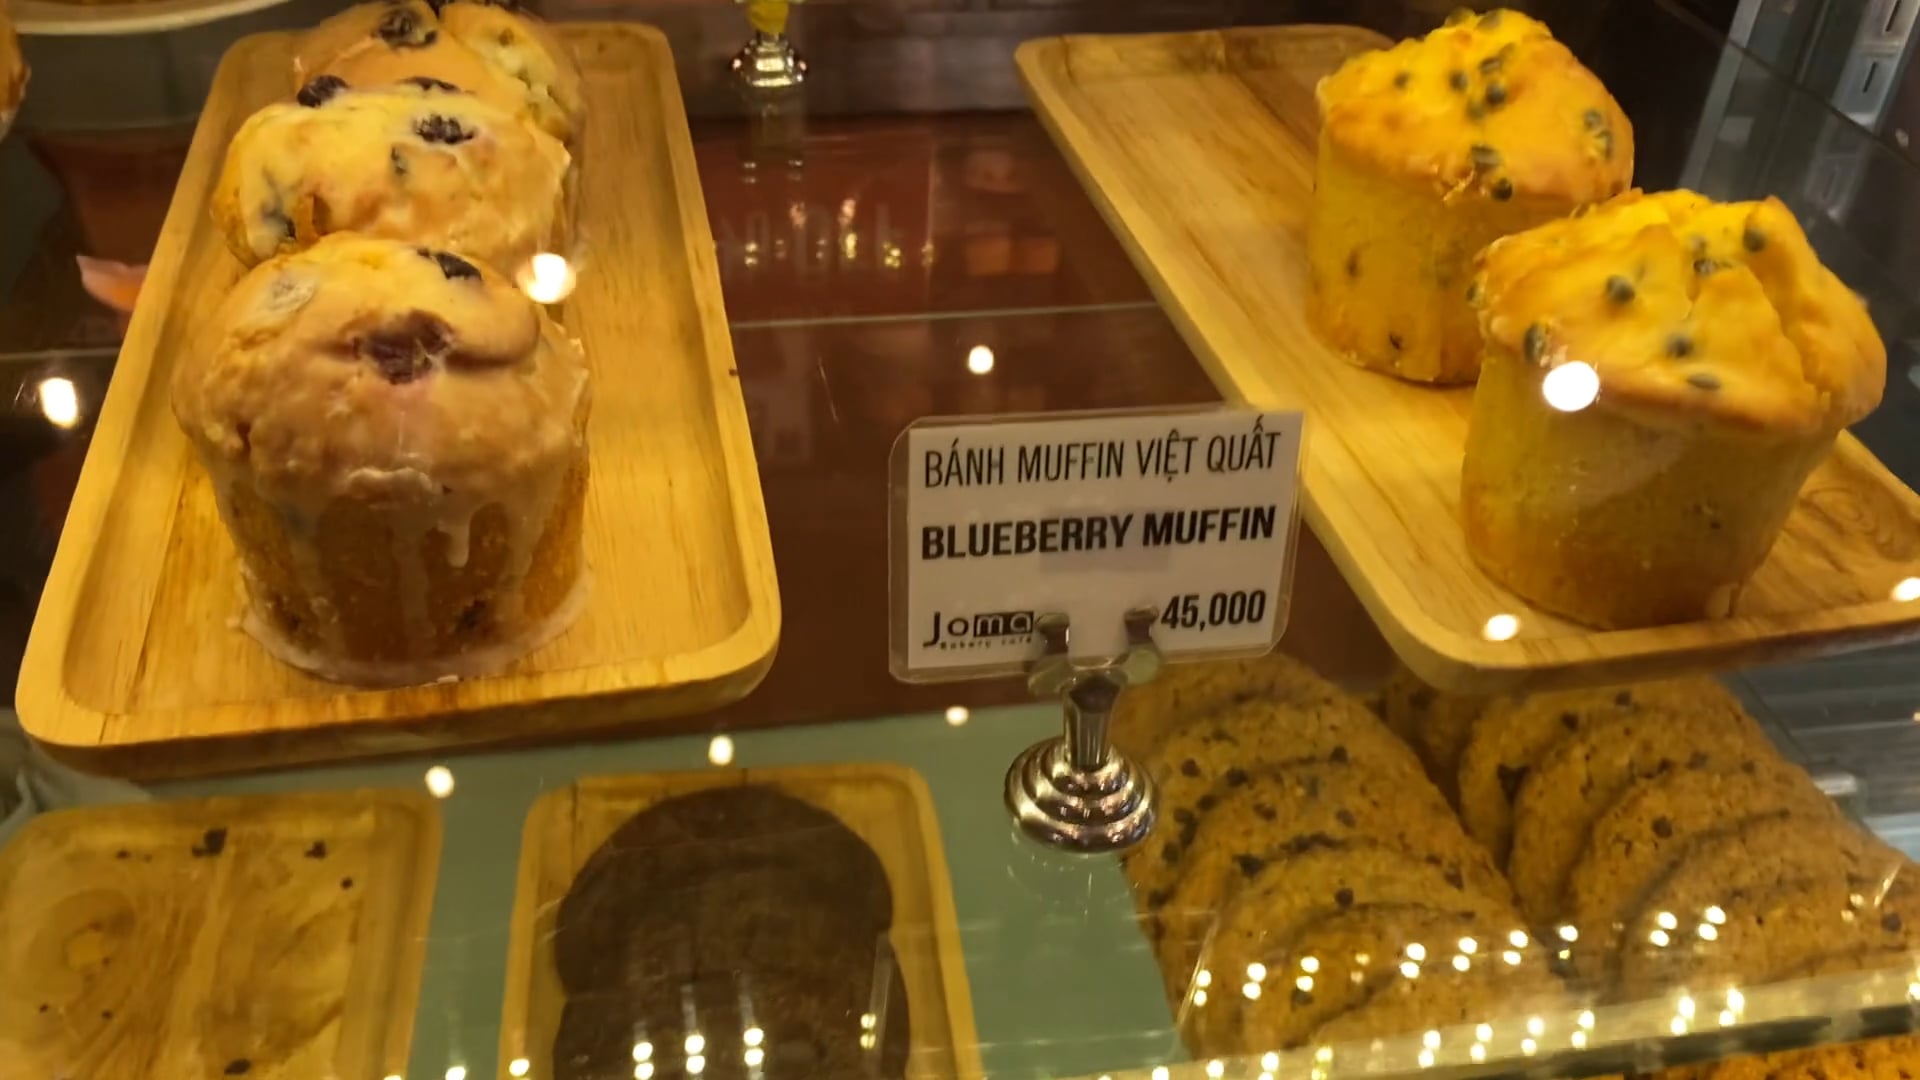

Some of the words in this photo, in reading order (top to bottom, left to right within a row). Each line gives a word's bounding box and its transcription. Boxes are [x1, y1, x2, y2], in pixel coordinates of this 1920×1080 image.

[925, 438, 1003, 488] BÁNH
[1017, 441, 1125, 483] MUFFIN
[1137, 429, 1198, 483] VIỆT
[1207, 415, 1281, 473] QUẤT
[922, 514, 1133, 560] BLUEBERRY
[1143, 506, 1276, 547] MUFFIN
[1161, 590, 1266, 631] 45,000
